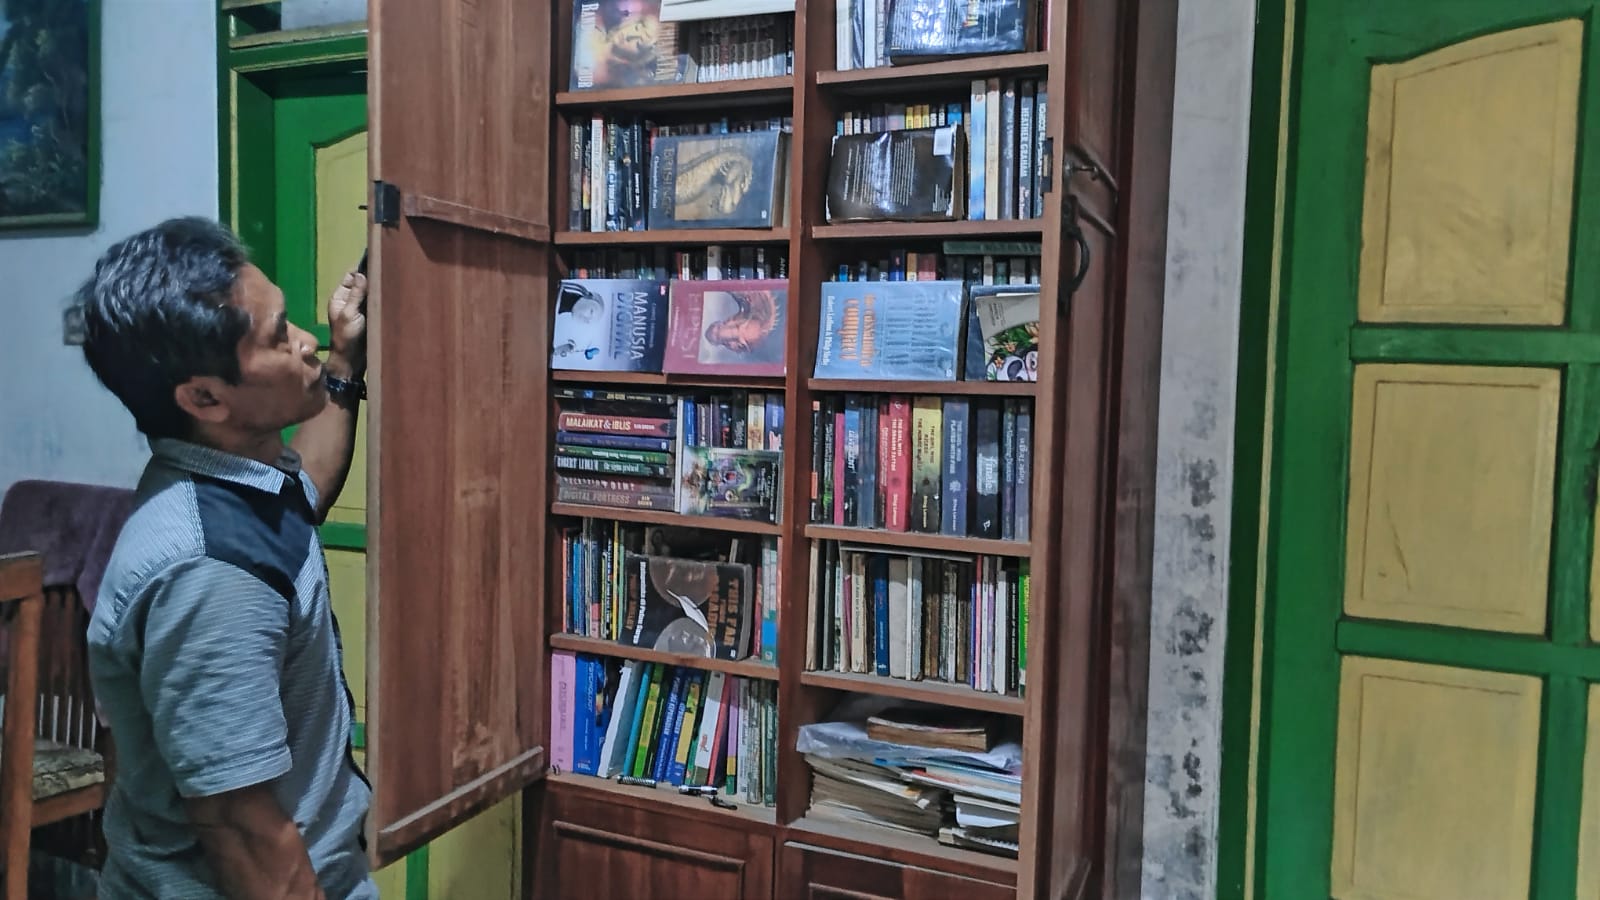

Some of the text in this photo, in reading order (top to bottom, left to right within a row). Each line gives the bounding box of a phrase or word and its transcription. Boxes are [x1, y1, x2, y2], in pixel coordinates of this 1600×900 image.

[1020, 107, 1030, 178] HEATHER GRAHAM
[614, 292, 634, 360] DIGITAL
[630, 291, 649, 360] MANUSIA
[565, 417, 631, 431] MALAIKAT & IBLIS
[562, 490, 631, 505] DIGITAL FORTRESS
[981, 456, 998, 490] finale
[723, 578, 739, 646] THIS FAR
[586, 662, 595, 713] PSYCHOLOGY
